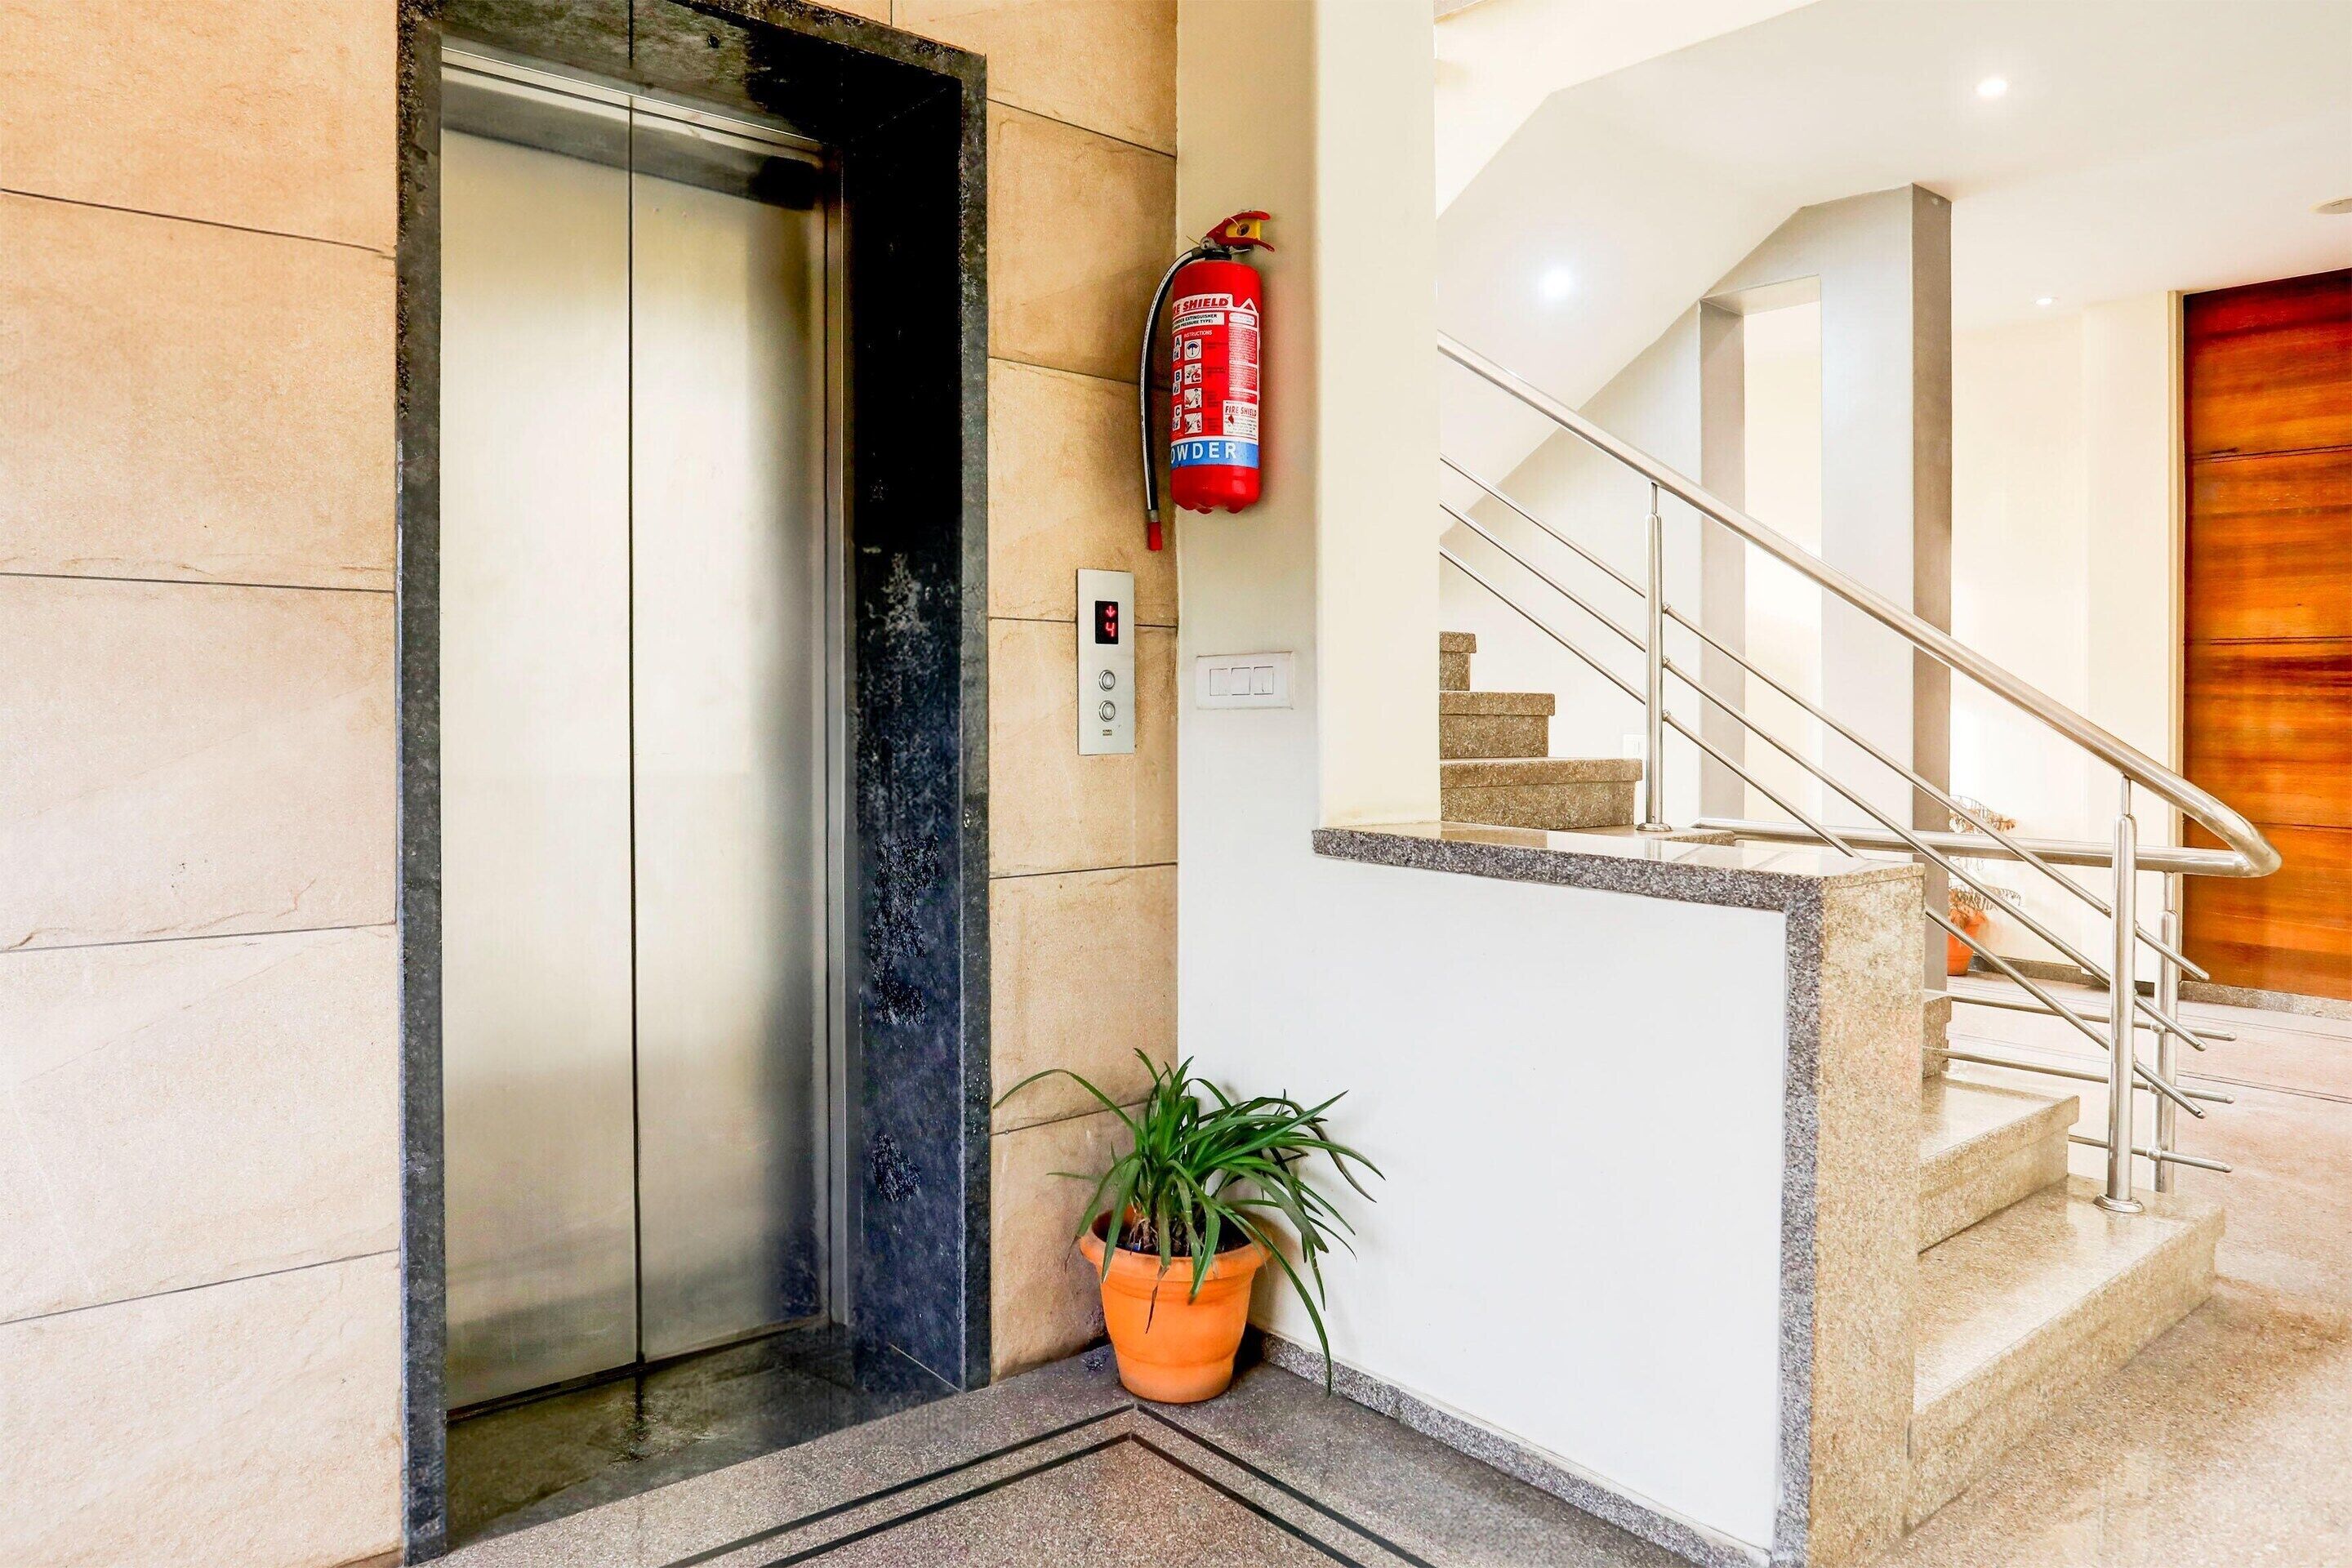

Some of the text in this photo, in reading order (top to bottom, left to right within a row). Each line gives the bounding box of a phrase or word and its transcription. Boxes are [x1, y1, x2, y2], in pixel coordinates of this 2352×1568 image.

[1183, 298, 1228, 310] SHIELD
[1184, 330, 1213, 338] INSTRUCTIONS
[1175, 337, 1180, 345] A
[1175, 372, 1180, 381] B
[1175, 407, 1180, 416] C
[1225, 405, 1257, 416] FIRE SHIELD
[1105, 621, 1116, 637] 4
